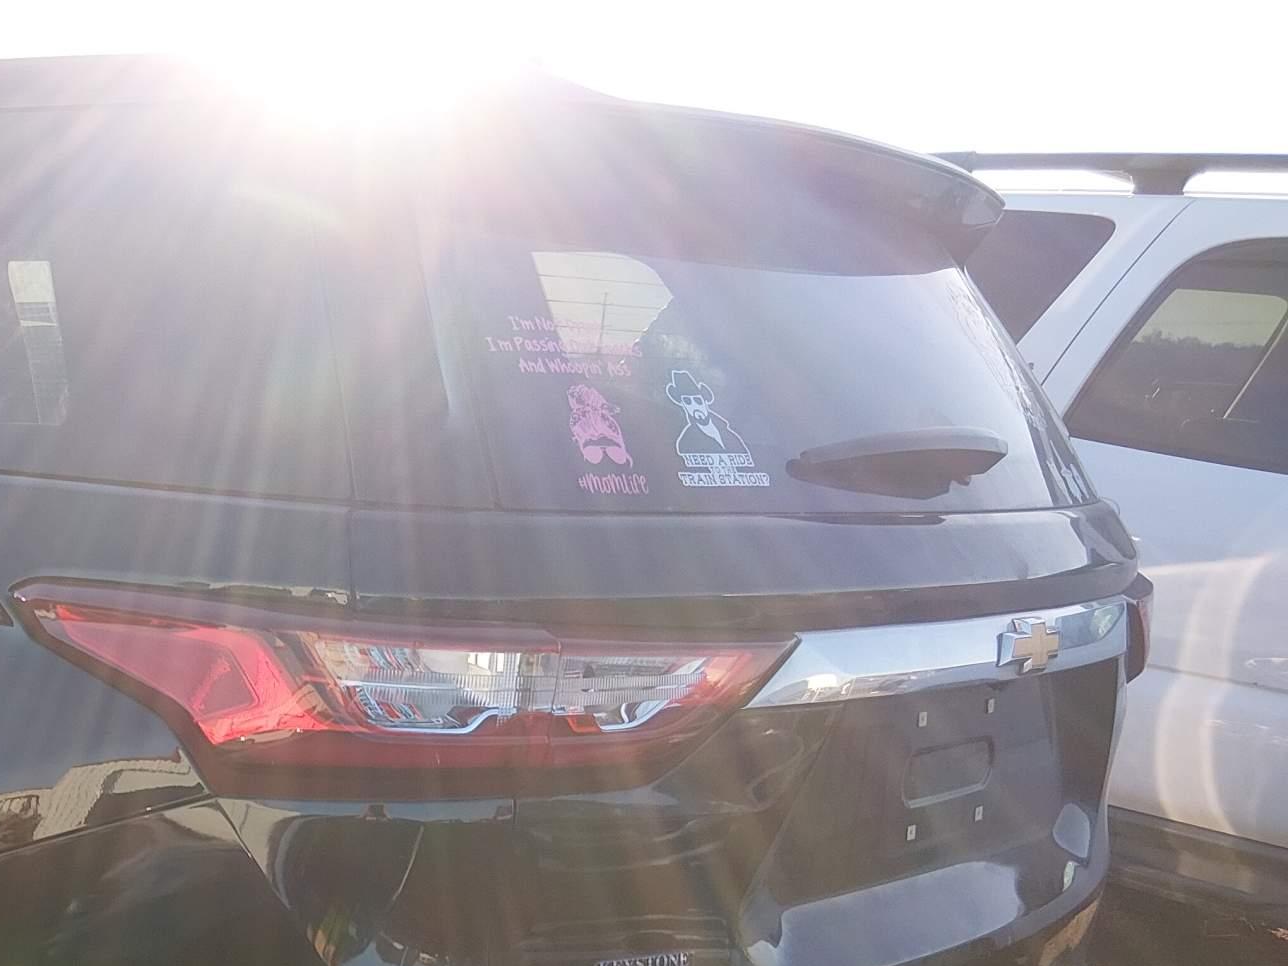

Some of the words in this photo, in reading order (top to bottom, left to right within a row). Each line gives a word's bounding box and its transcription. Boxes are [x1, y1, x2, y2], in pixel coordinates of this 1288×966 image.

[683, 454, 714, 467] NEED
[718, 455, 727, 467] A
[729, 454, 753, 467] RIDE
[680, 473, 716, 486] TRAIN
[719, 473, 770, 487] STATION?
